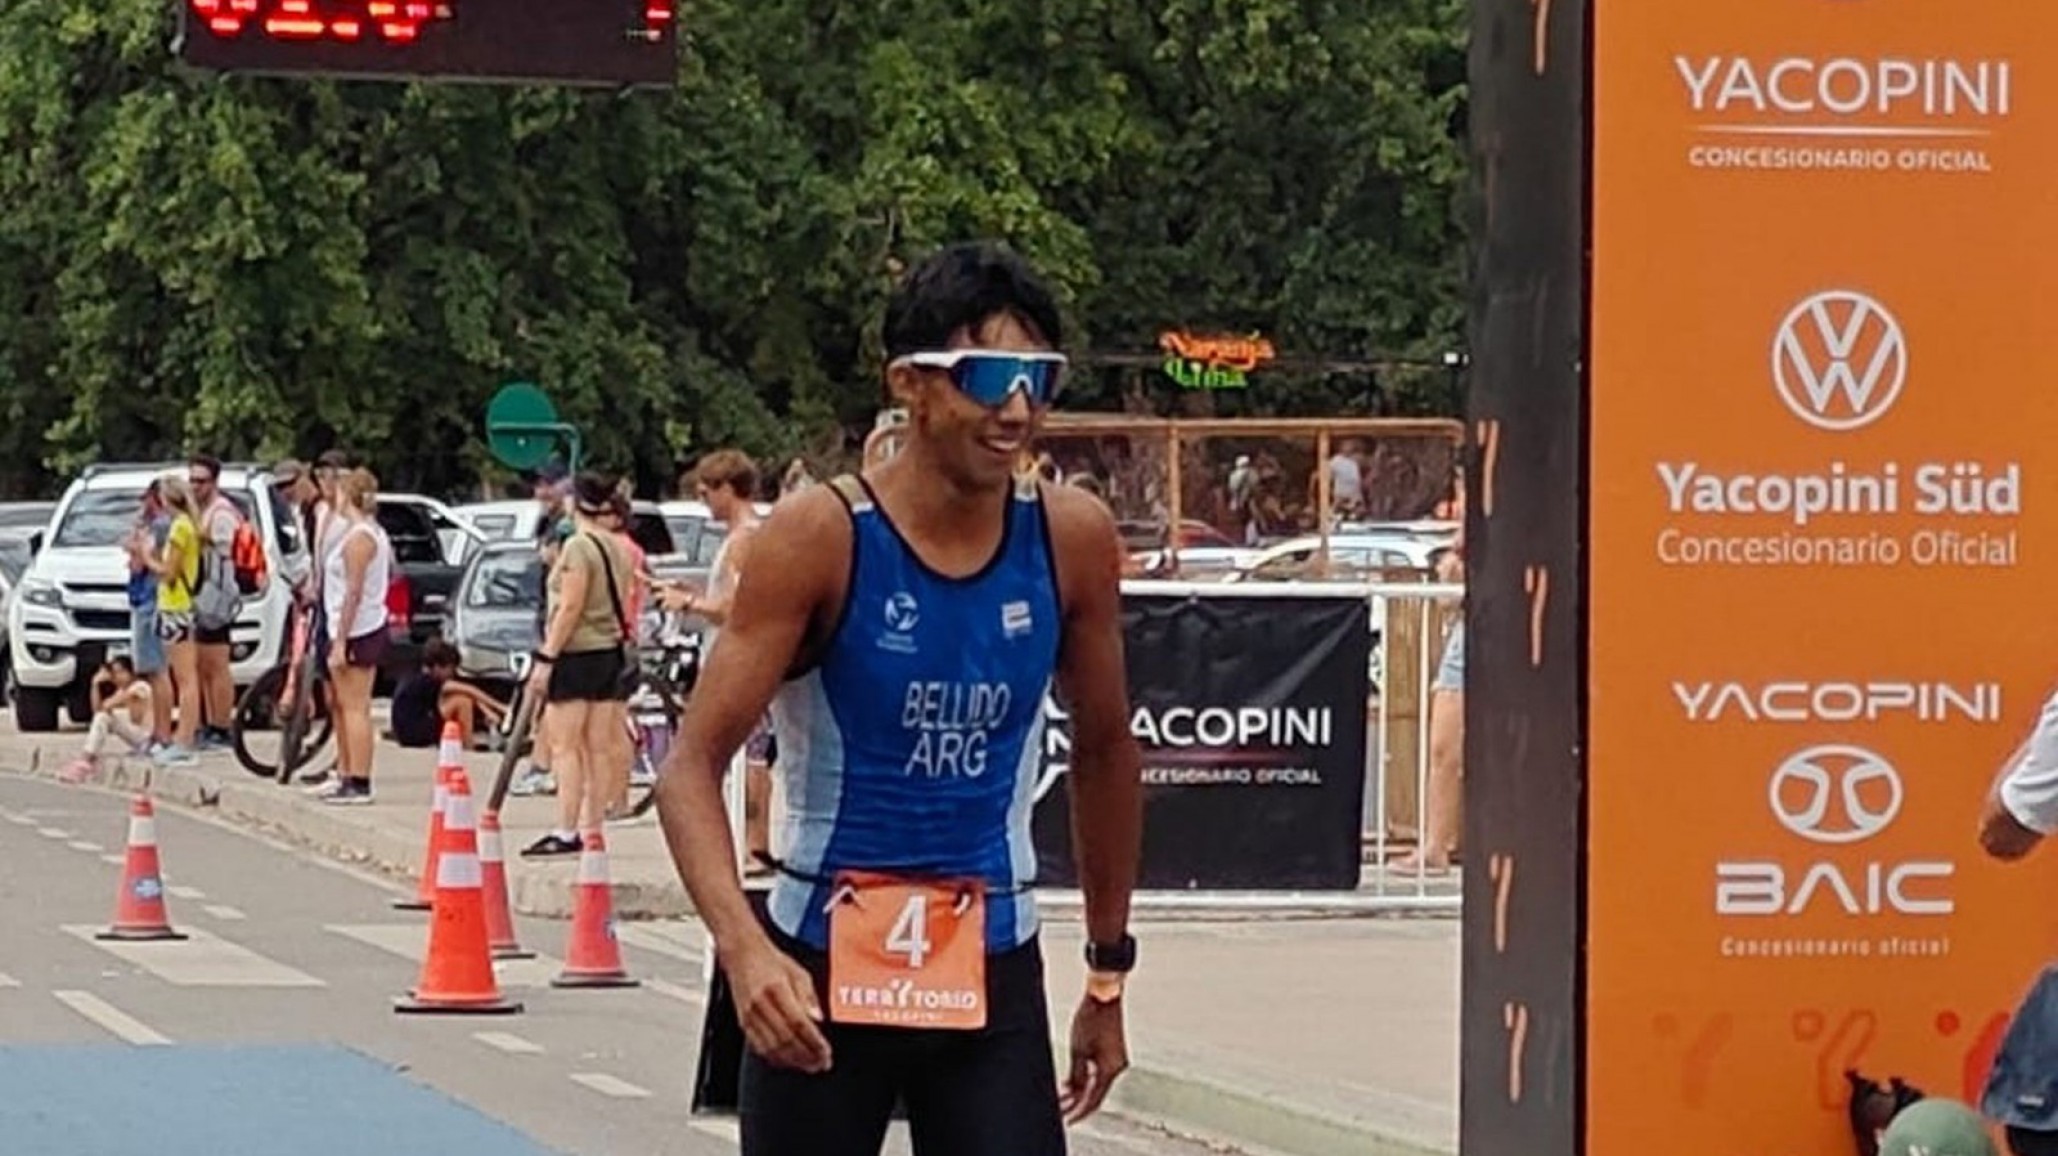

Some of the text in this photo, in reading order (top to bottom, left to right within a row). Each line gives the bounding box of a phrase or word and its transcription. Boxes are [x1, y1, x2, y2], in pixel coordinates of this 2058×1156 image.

[1675, 56, 2010, 115] YACOPINI
[1688, 146, 1992, 172] CONCESIONARIO OFICIAL
[1656, 462, 2021, 525] Yacopini Süd
[1657, 530, 2018, 566] Concesionario Oficial
[903, 681, 1011, 729] BELLIDO
[1673, 682, 2001, 721] YACOPINI
[1130, 707, 1332, 746] ACOPINI
[904, 730, 987, 777] ARG
[1256, 769, 1322, 785] OFICIAL
[1716, 862, 1955, 914] BAIC
[886, 895, 931, 967] 4
[1721, 936, 1949, 956] Concesionario oficial
